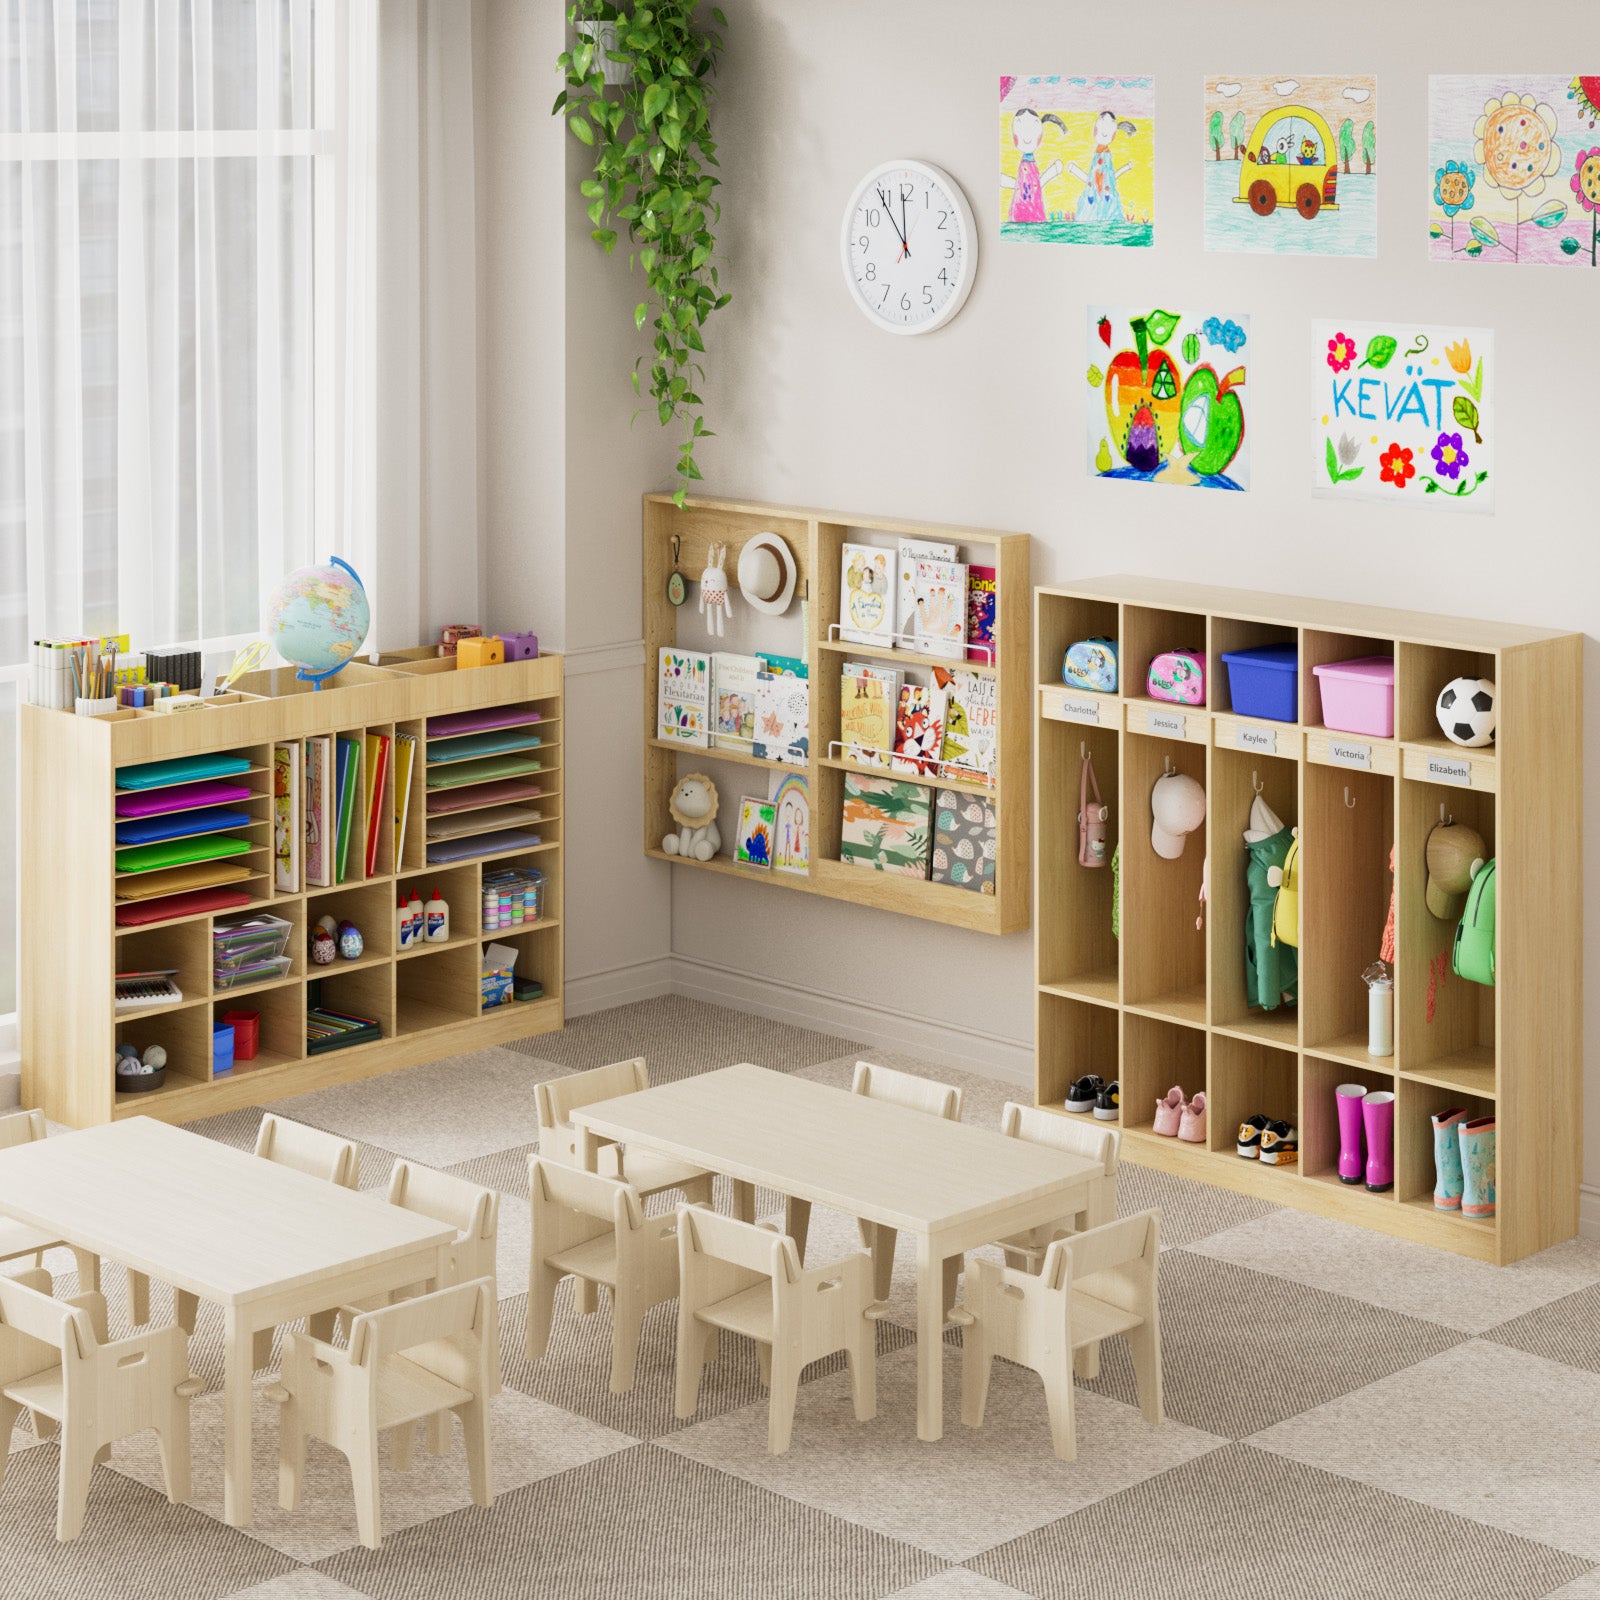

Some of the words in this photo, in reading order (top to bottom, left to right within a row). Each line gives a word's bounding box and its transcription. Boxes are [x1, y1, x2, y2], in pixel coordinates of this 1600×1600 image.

[881, 189, 891, 208] 11
[899, 183, 914, 202] 12
[925, 191, 929, 209] 1
[865, 209, 880, 227] 10
[937, 210, 948, 230] 2
[859, 235, 870, 254] 9
[944, 240, 955, 259] 3
[865, 263, 876, 281] 8
[937, 267, 948, 286] 4
[881, 283, 891, 303] 7
[900, 292, 911, 311] 6
[922, 285, 932, 305] 5
[1333, 365, 1456, 431] KEVÄT
[664, 686, 705, 702] Flexitarian
[1064, 703, 1097, 716] Charlotte
[1153, 718, 1178, 730] Jessica
[1243, 732, 1268, 745] Kaylee
[1334, 747, 1365, 761] Victoria
[1429, 763, 1467, 777] Elizabeth
